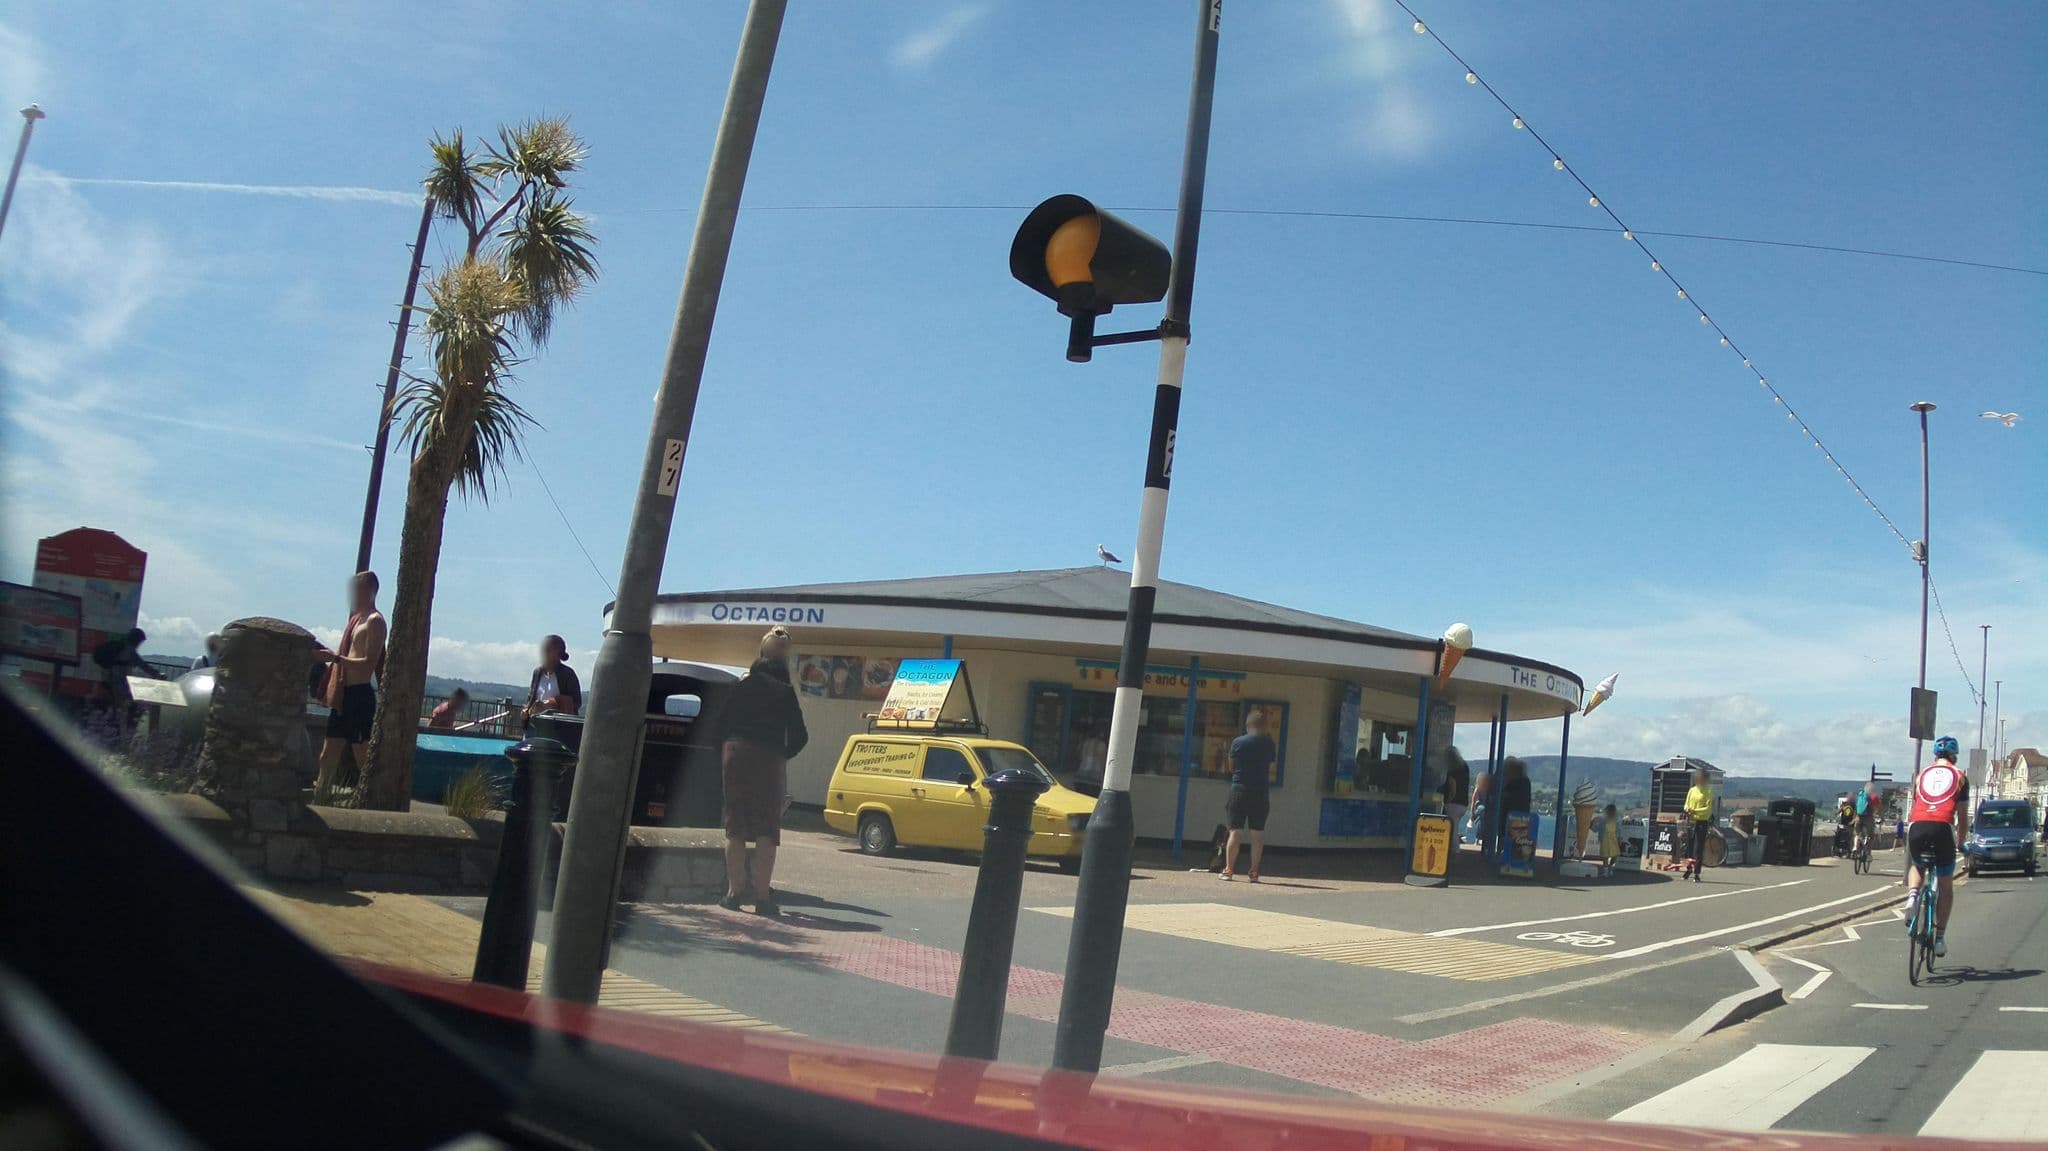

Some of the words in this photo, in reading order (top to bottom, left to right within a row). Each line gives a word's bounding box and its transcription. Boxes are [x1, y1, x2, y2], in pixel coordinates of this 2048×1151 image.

[667, 442, 682, 487] 27
[711, 603, 824, 624] OCTAGON
[897, 671, 953, 680] OCTAGON
[1511, 666, 1538, 688] THE
[856, 744, 888, 754] TROTTERS
[848, 757, 885, 768] INDEPENDENT
